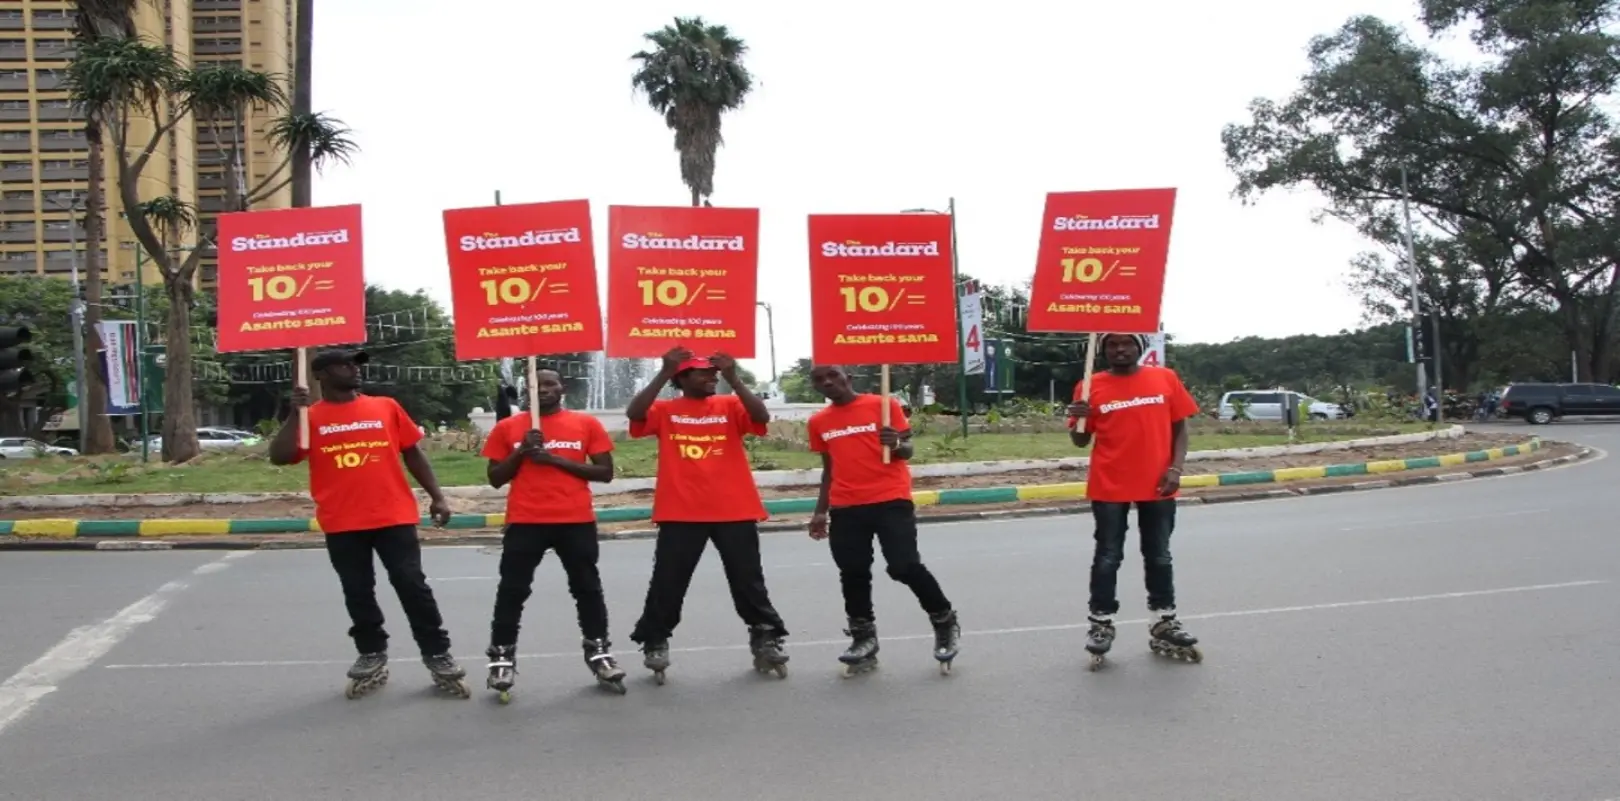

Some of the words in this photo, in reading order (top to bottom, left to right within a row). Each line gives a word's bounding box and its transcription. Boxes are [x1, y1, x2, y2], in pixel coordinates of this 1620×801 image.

[1053, 214, 1160, 231] Standard
[232, 229, 349, 252] Standard
[460, 227, 581, 251] Standard
[622, 232, 744, 251] Standard
[821, 241, 939, 257] Standard
[1062, 246, 1086, 254] Take
[1087, 246, 1115, 254] back
[1115, 247, 1140, 255] your
[246, 266, 275, 274] Take
[277, 263, 305, 272] back
[307, 261, 334, 271] your
[478, 267, 507, 276] Take
[509, 264, 539, 273] back
[540, 262, 567, 273] your
[637, 266, 666, 276] Take
[668, 267, 698, 276] back
[700, 269, 727, 278] your
[1060, 258, 1137, 283] 10/=
[838, 274, 866, 282] Take
[868, 273, 897, 282] back
[899, 275, 925, 283] your
[248, 275, 335, 301] 10/=
[480, 277, 570, 305] 10/=
[637, 279, 727, 307] 10/=
[839, 286, 926, 313] 10/=
[1047, 302, 1101, 313] Asante
[1103, 304, 1142, 314] sana
[240, 318, 302, 332] Asante
[304, 315, 346, 327] sana
[477, 324, 539, 338] Asante
[541, 321, 584, 333] sana
[629, 327, 692, 338] Asante
[695, 328, 736, 338] sana
[833, 333, 896, 344] Asante
[897, 332, 939, 343] sana
[965, 324, 980, 352] 4
[1143, 350, 1159, 366] 4
[1099, 394, 1165, 414] Standard
[318, 420, 384, 435] Standard
[821, 422, 877, 442] Standard
